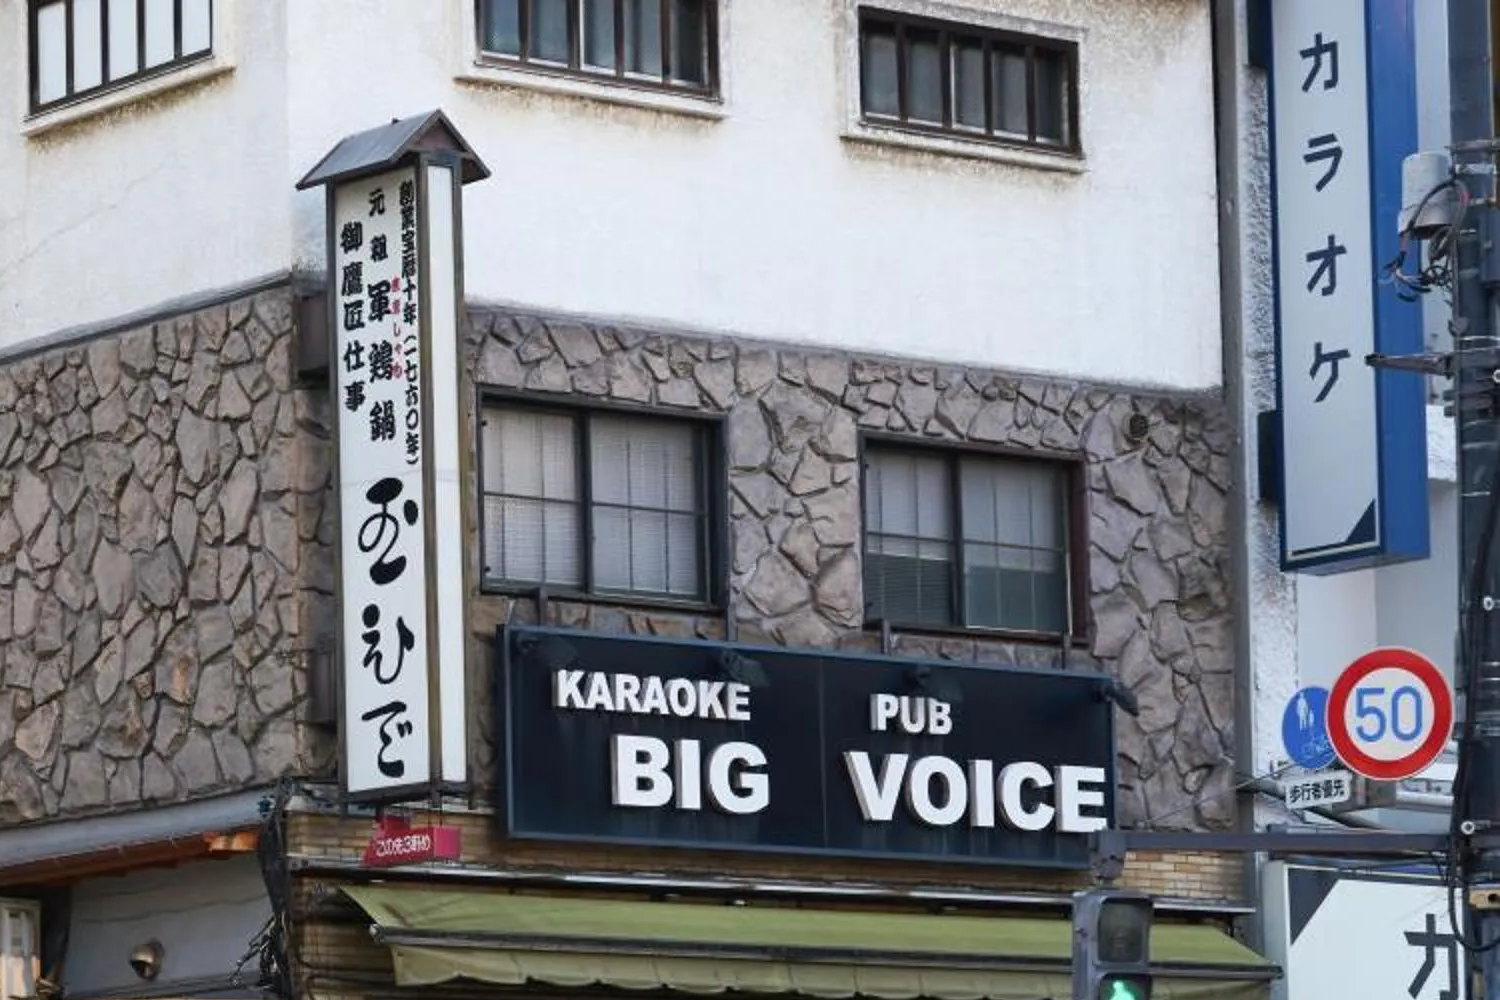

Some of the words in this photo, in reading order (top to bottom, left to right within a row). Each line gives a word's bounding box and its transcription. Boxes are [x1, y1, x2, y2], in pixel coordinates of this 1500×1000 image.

[1300, 32, 1351, 403] カラオケ
[555, 668, 752, 722] KARAOKE
[870, 692, 953, 737] PUB
[1354, 685, 1424, 743] 50
[611, 732, 771, 815] BIG
[845, 749, 1109, 835] VOICE
